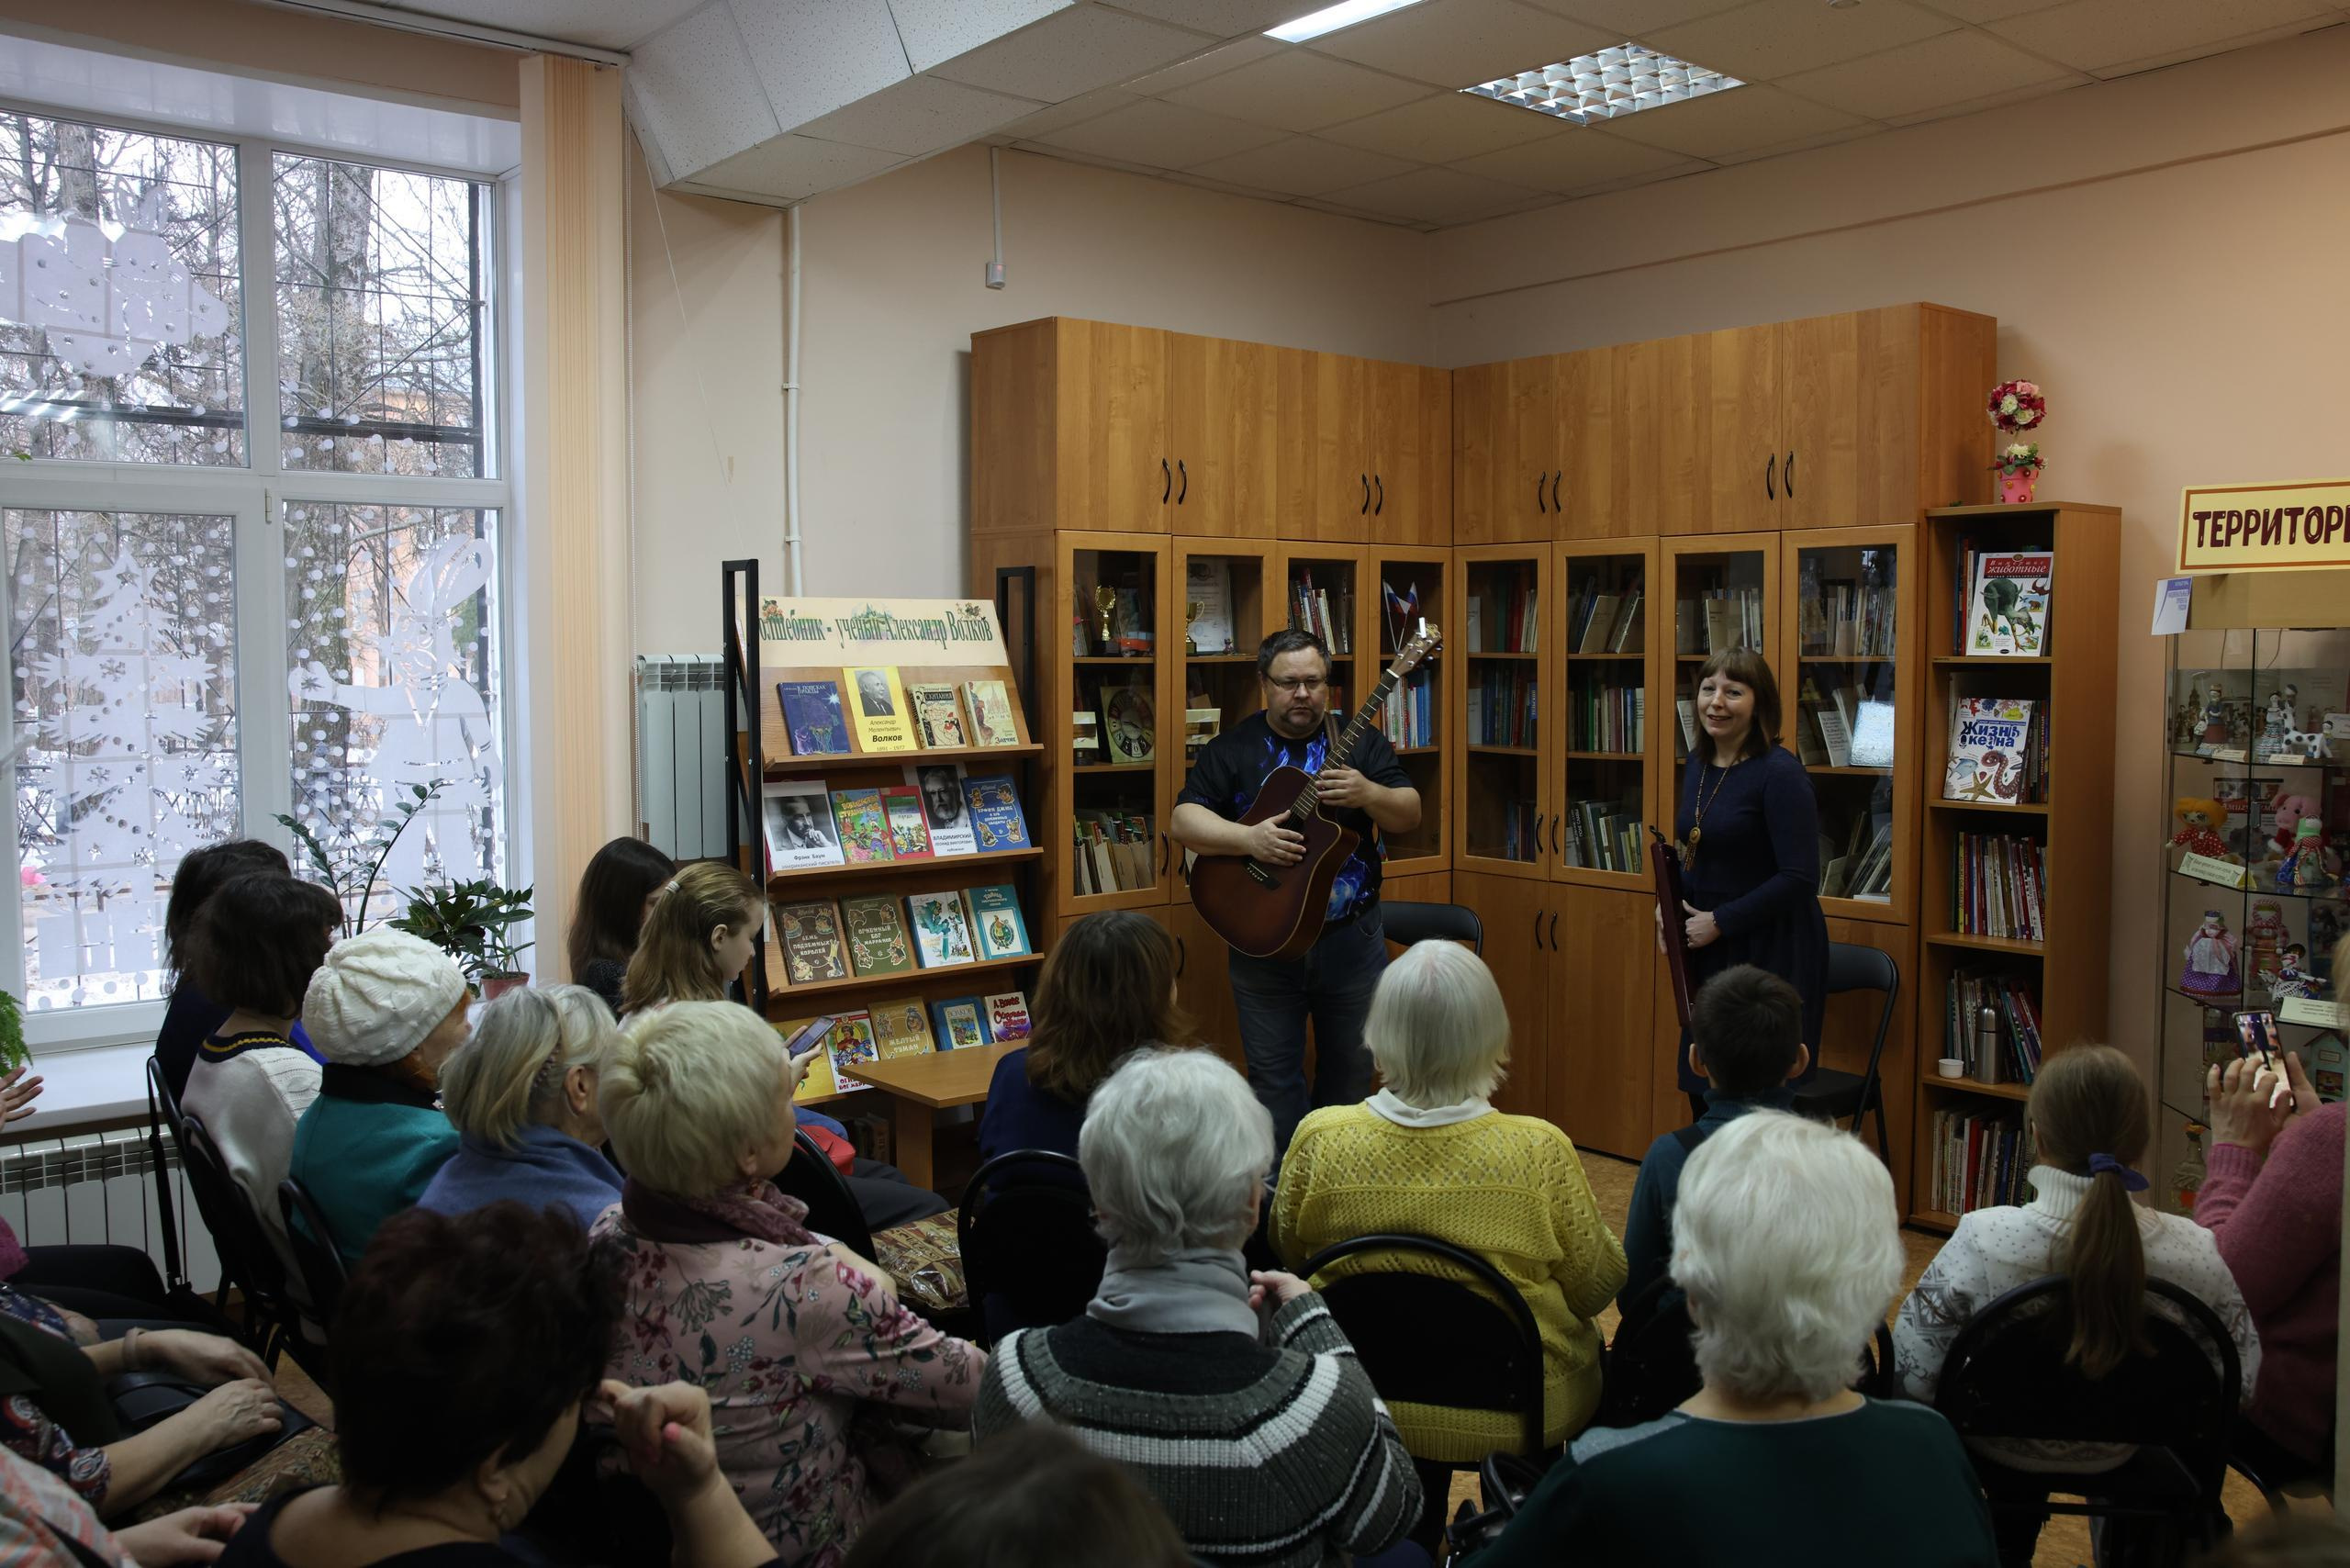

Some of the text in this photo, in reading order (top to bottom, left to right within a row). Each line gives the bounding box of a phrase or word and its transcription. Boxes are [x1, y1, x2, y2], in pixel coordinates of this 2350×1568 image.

[2192, 505, 2350, 548] ТЕРРИТОР
[1987, 564, 2047, 574] животные
[759, 609, 826, 641] олшебник
[946, 610, 993, 642] Волков
[1961, 720, 2020, 737] Жизнь
[872, 734, 902, 743] Волков
[858, 926, 891, 935] ОГНЕННЫЙ
[793, 940, 830, 949] ПОДЗЕМНЫХ
[800, 947, 826, 956] КОРОЛЕЙ
